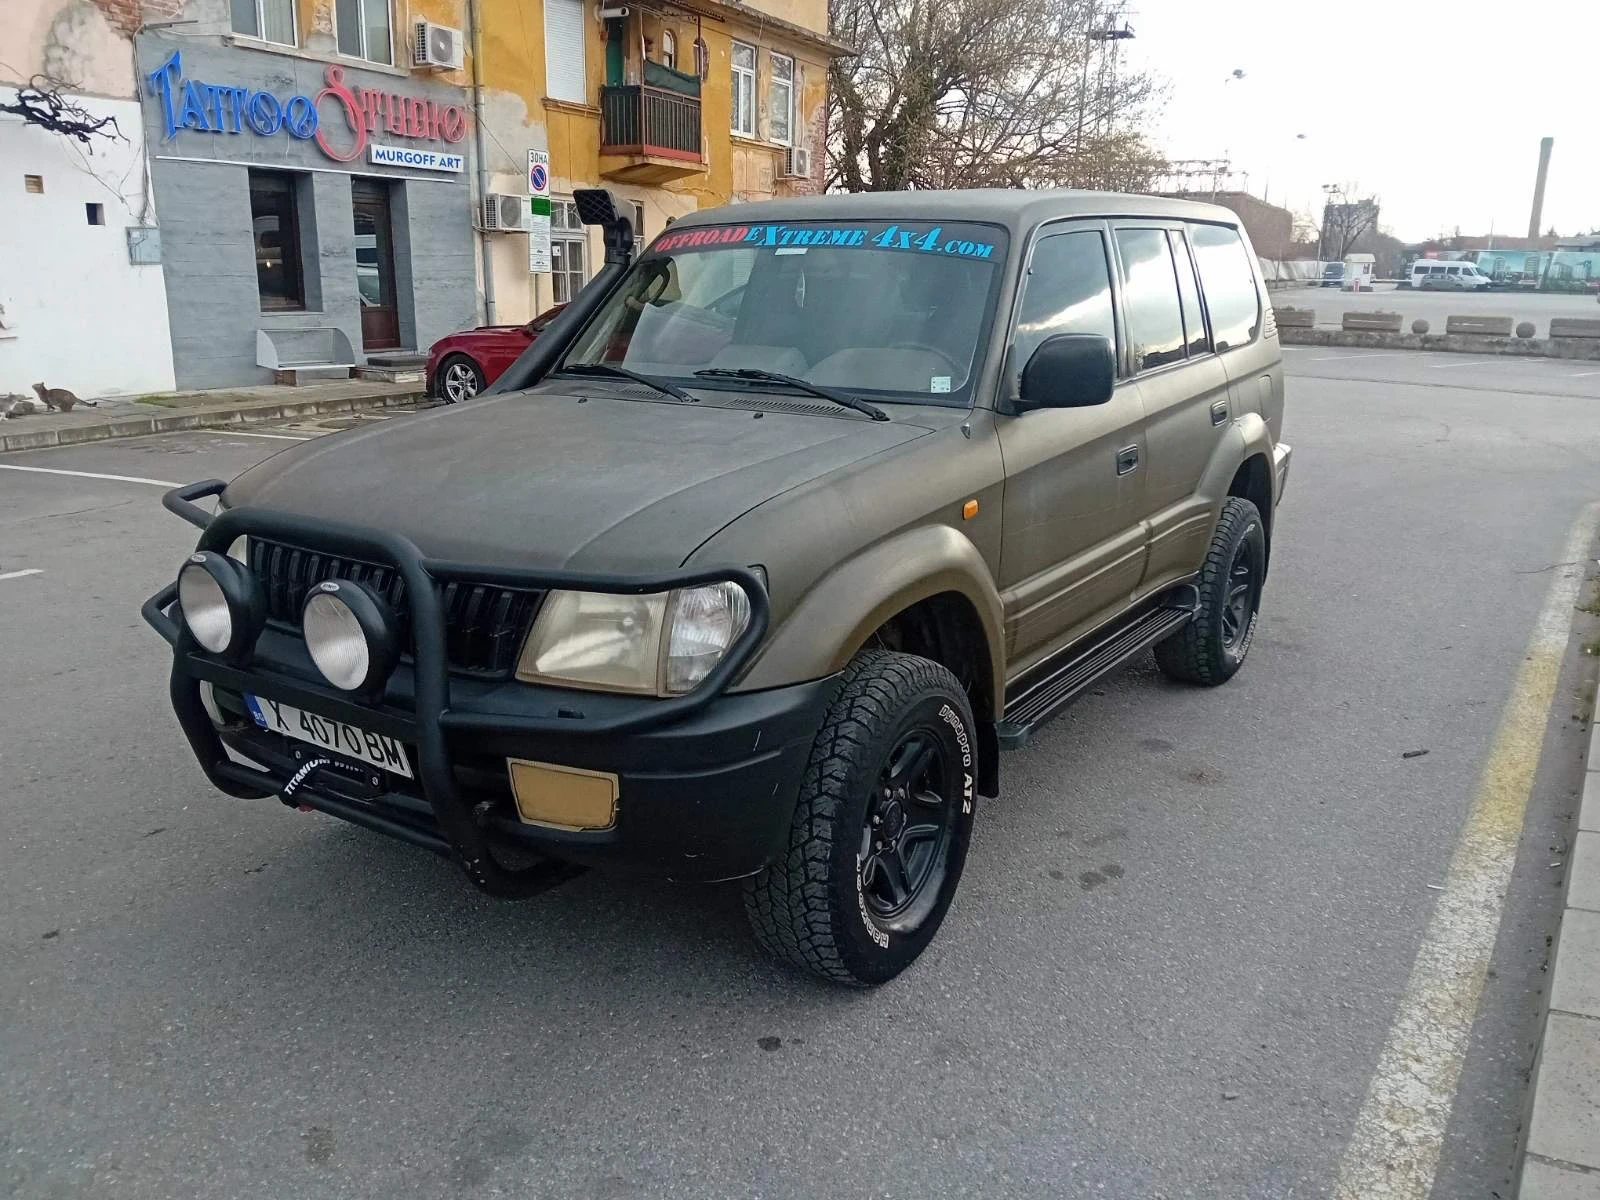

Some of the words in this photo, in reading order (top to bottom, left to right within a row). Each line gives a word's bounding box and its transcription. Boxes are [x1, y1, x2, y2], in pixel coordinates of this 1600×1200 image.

[375, 149, 436, 166] MURGOFF
[440, 156, 461, 169] ART
[300, 711, 361, 755] 4070
[361, 729, 405, 771] BM
